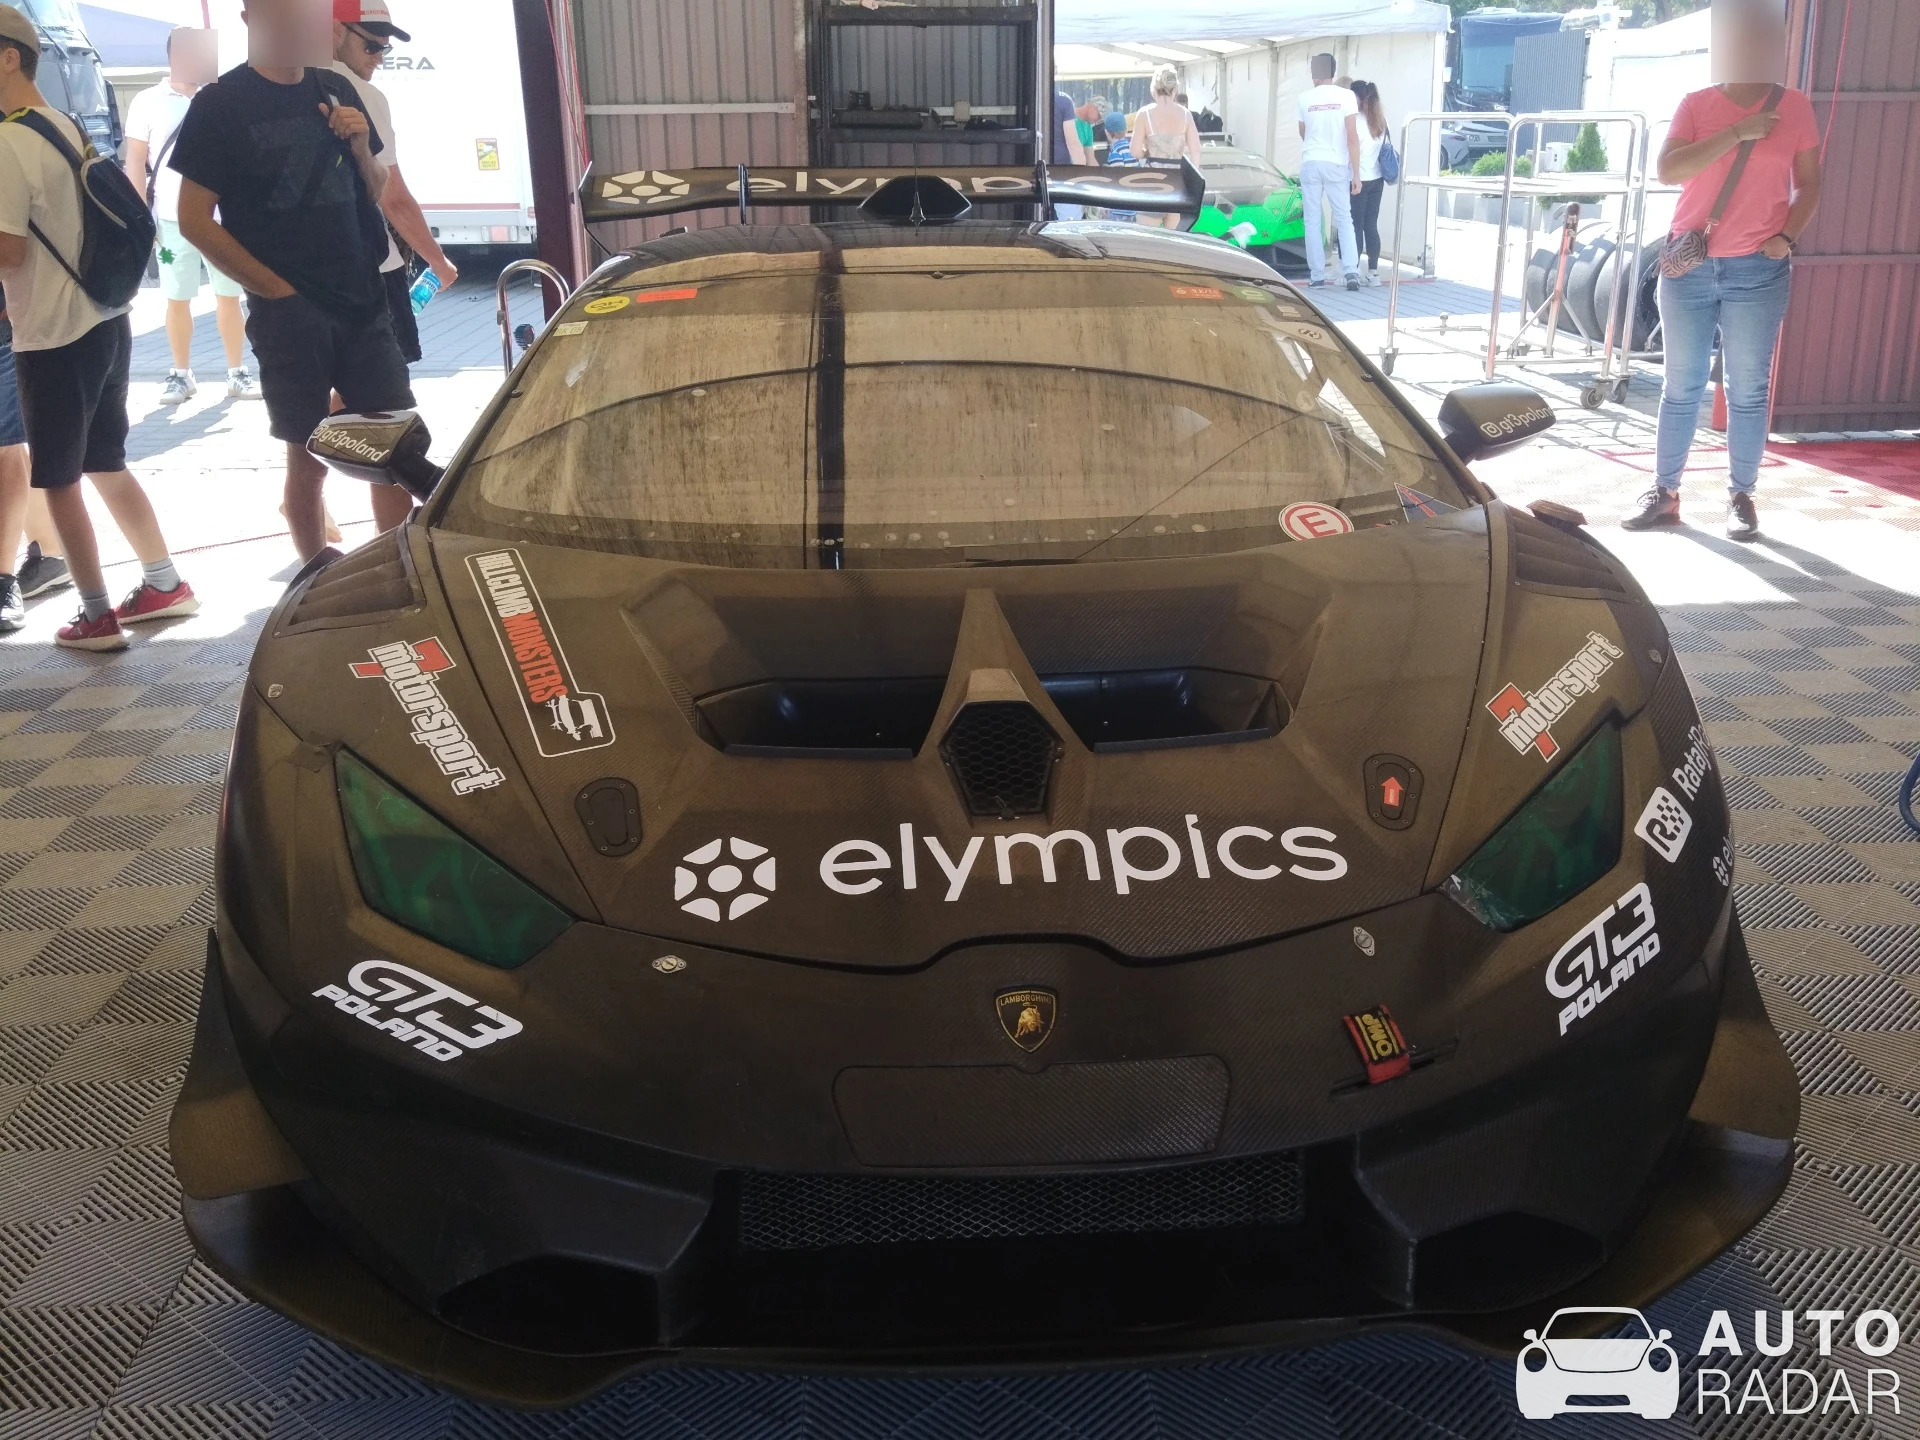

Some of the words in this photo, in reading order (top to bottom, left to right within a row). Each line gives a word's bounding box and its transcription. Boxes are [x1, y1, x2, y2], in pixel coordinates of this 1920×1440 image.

[374, 56, 436, 71] ERA
[726, 171, 1175, 195] elypcs
[1296, 511, 1338, 539] E
[368, 641, 505, 795] motorsport
[1500, 631, 1623, 754] motorsport
[819, 814, 1348, 901] elympics
[1545, 882, 1656, 999] GT3
[311, 983, 463, 1062] POLAND
[347, 960, 524, 1049] GT3
[1558, 932, 1661, 1037] POLAND
[1361, 1013, 1393, 1057] OMP
